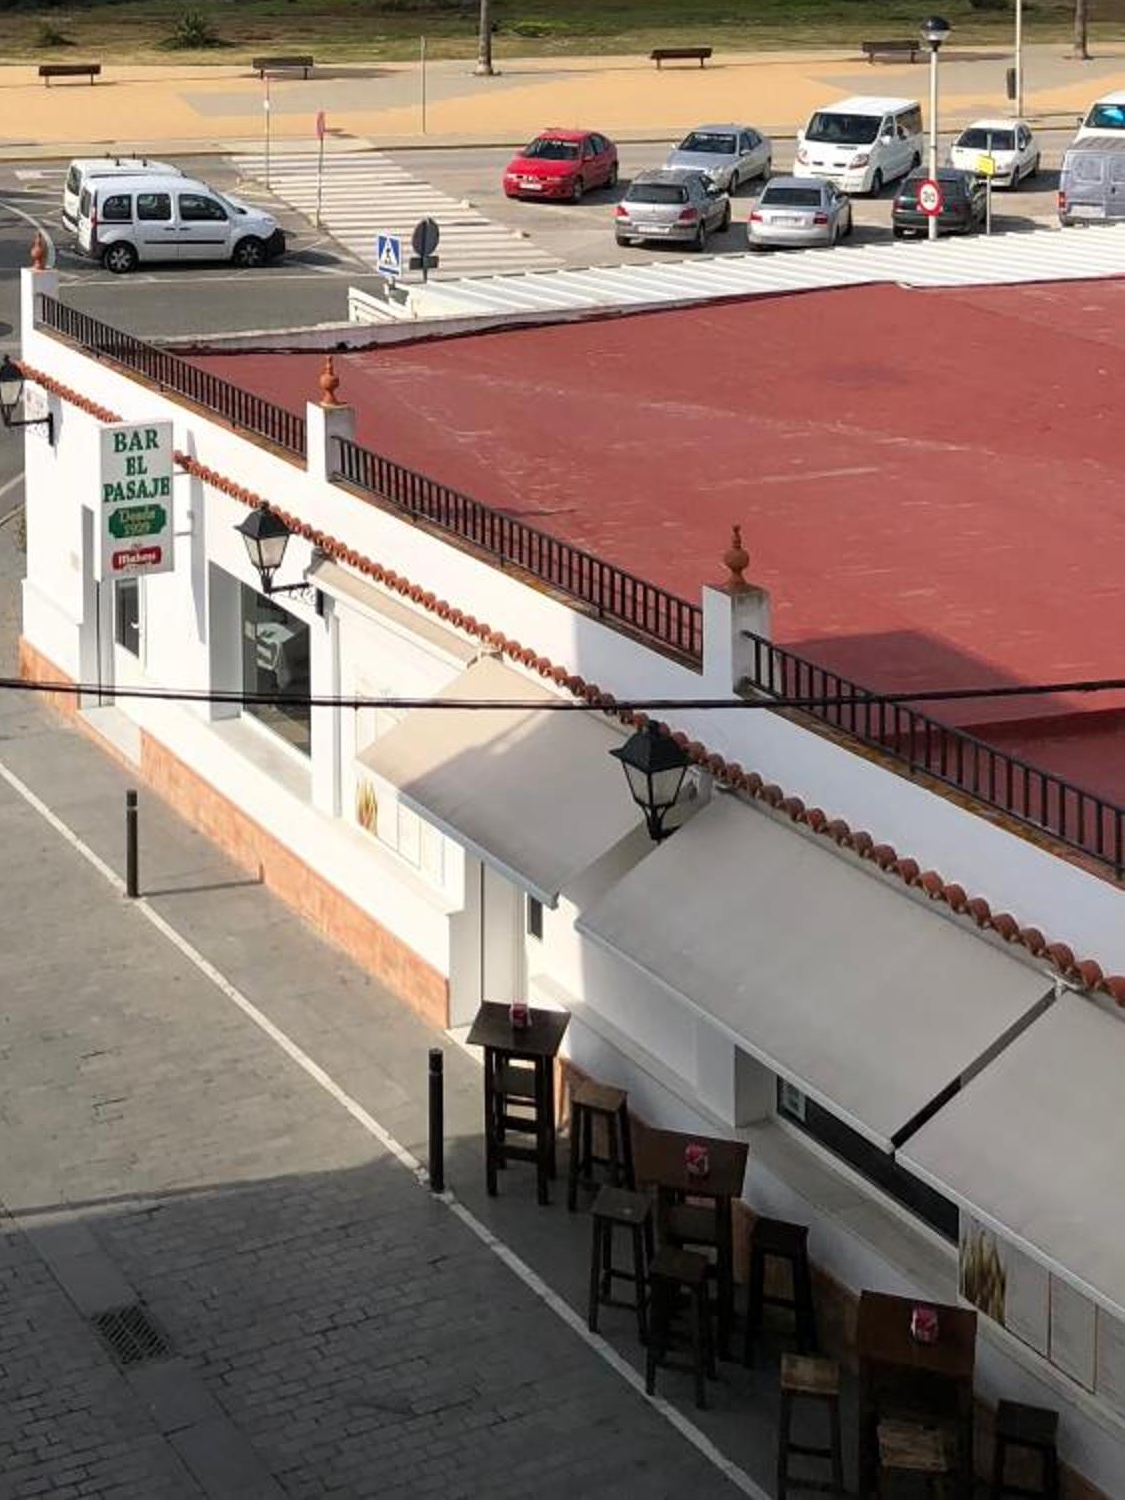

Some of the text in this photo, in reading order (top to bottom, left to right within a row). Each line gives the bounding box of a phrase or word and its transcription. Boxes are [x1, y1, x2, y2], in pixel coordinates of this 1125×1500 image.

[113, 429, 159, 453] BAR
[126, 456, 148, 477] EL
[103, 476, 170, 502] PASAJE
